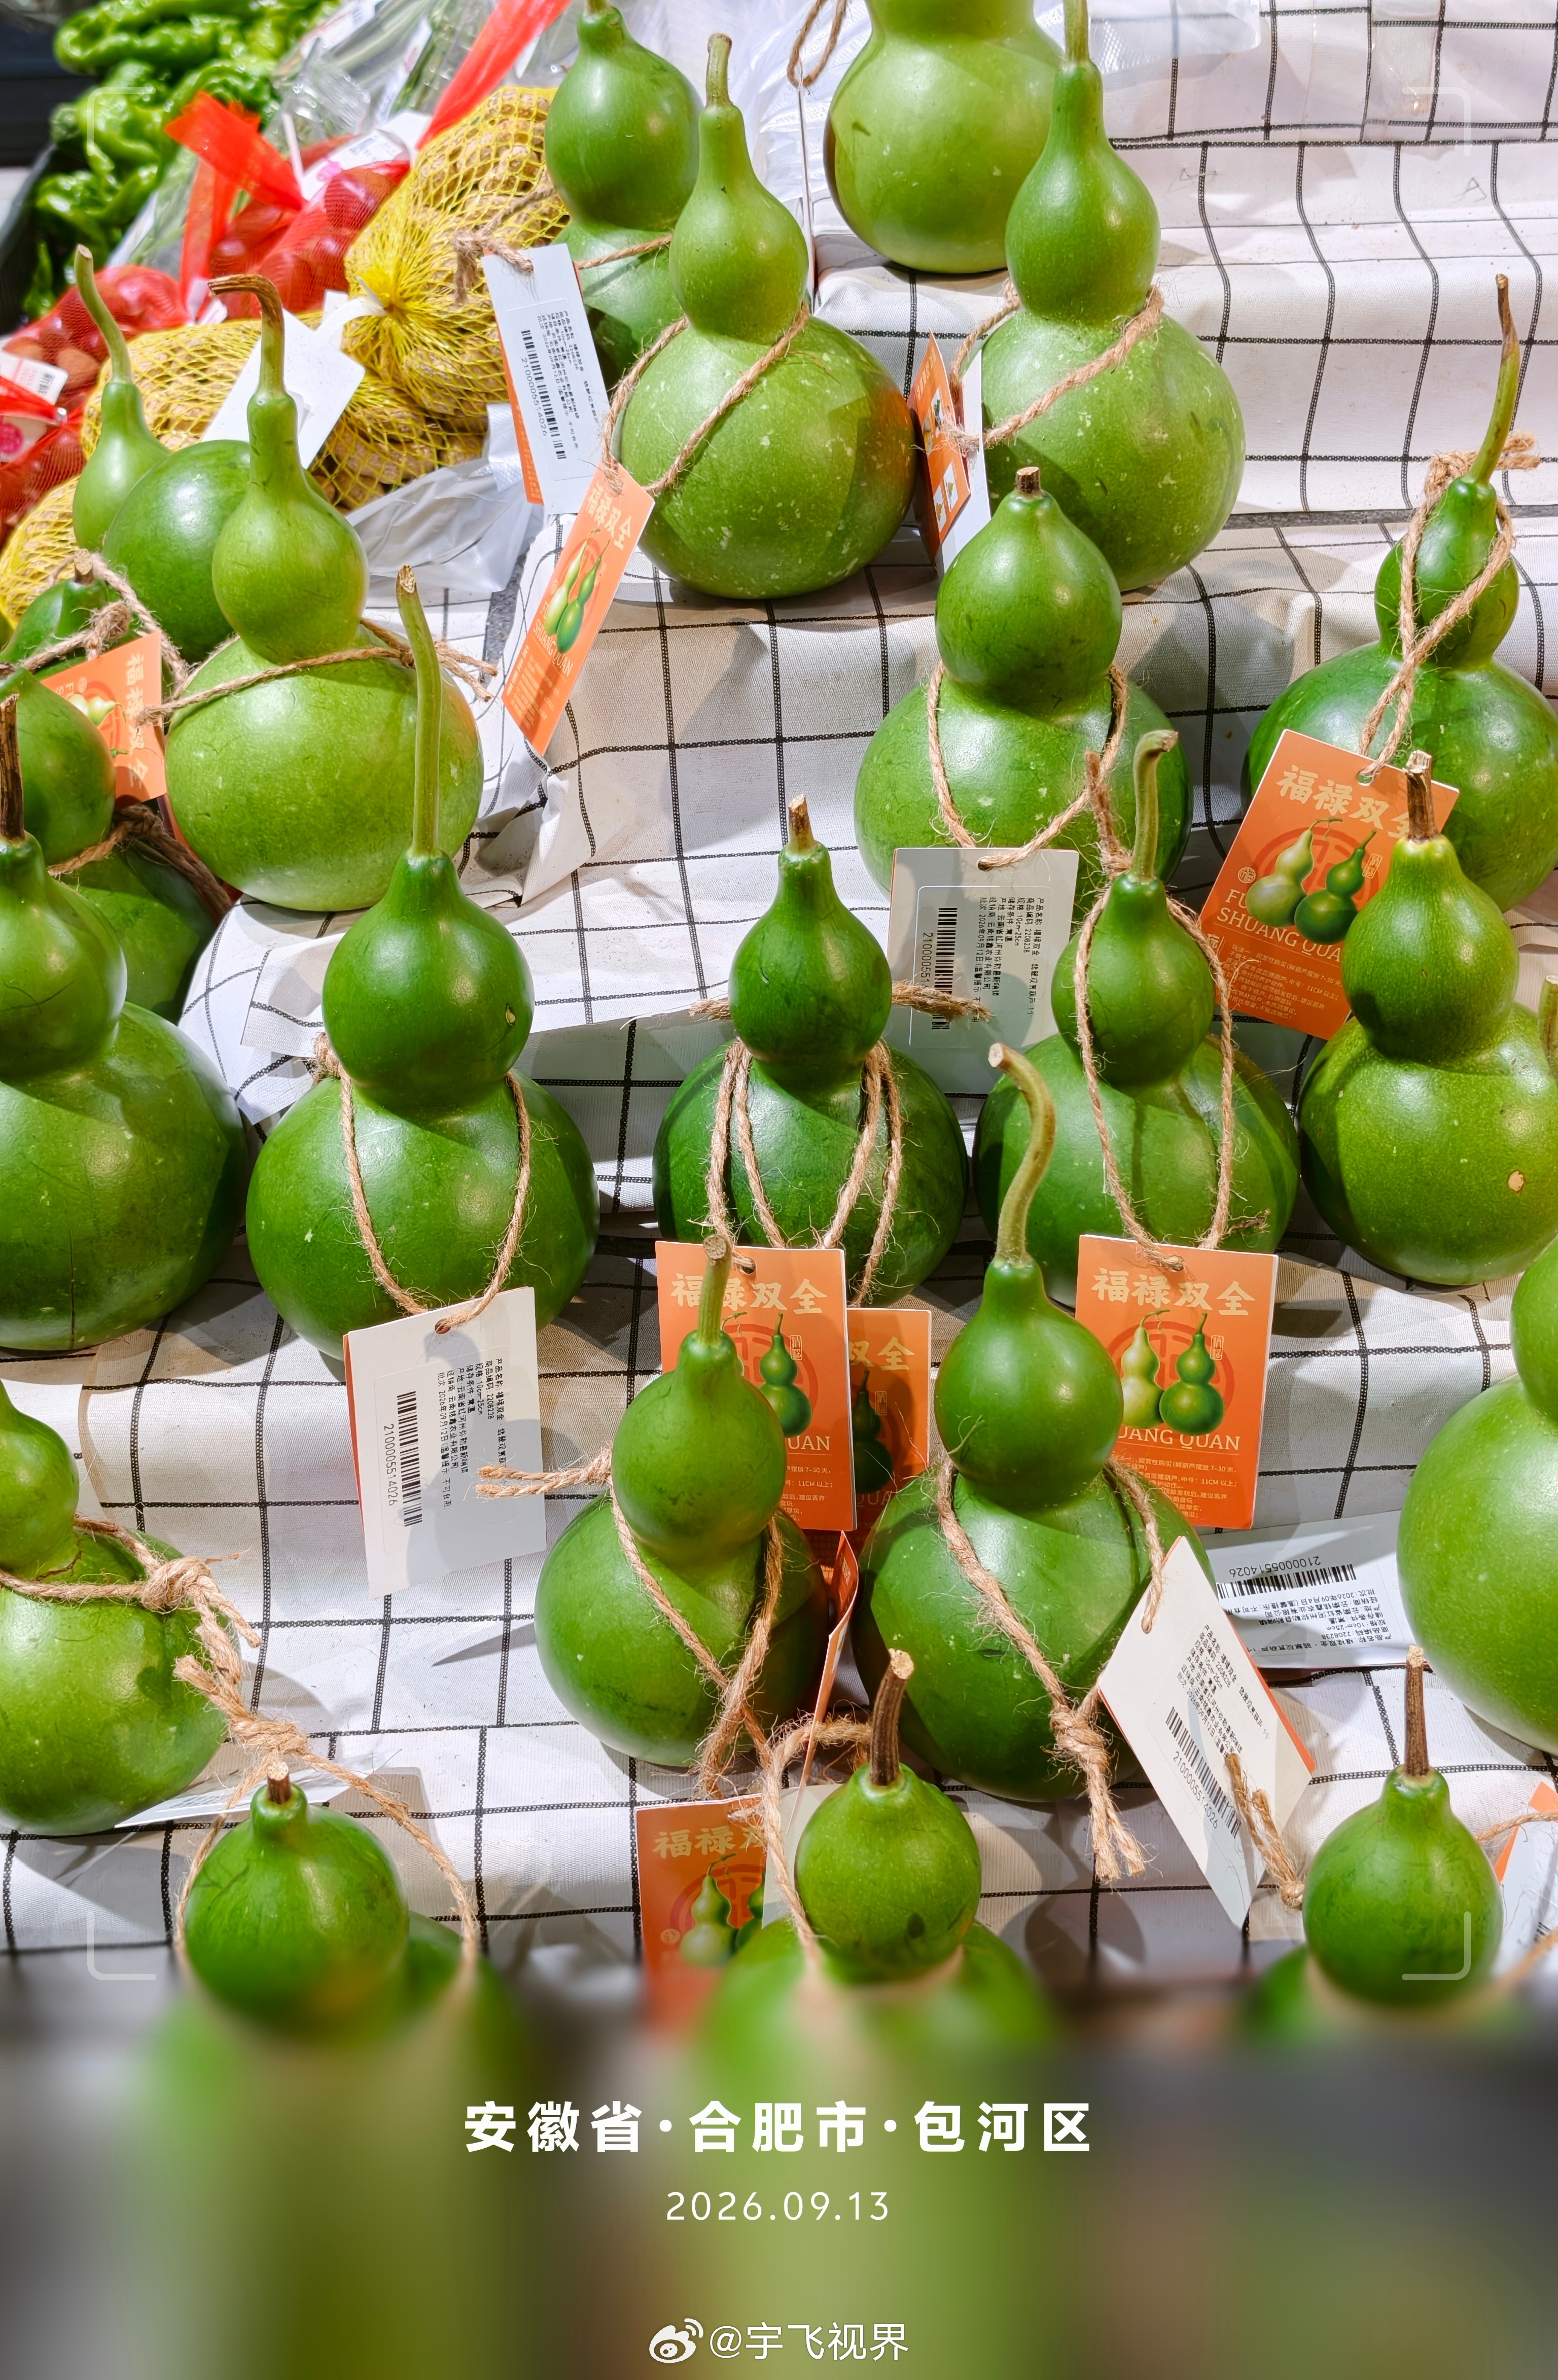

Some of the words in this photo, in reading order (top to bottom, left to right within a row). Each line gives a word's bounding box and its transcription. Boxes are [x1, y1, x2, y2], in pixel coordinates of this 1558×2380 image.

[521, 357, 548, 437] 2100005514026
[585, 484, 632, 551] 福禄双全
[533, 617, 556, 656] SHUANG
[551, 647, 573, 678] QUAN
[919, 932, 933, 988] 210000551
[1217, 908, 1297, 946] SHUANG
[1302, 934, 1341, 963] QUA
[1091, 1267, 1256, 1316] 福禄双全
[849, 1337, 915, 1371] 双全
[383, 1423, 399, 1506] 2100005514026
[788, 1436, 830, 1451] UAN
[1118, 1428, 1174, 1446] UANG
[1179, 1433, 1241, 1450] QUAN
[1228, 1556, 1321, 1578] 2100005514026
[1172, 1748, 1220, 1832] 2100005514026
[652, 1826, 765, 1859] 福禄
